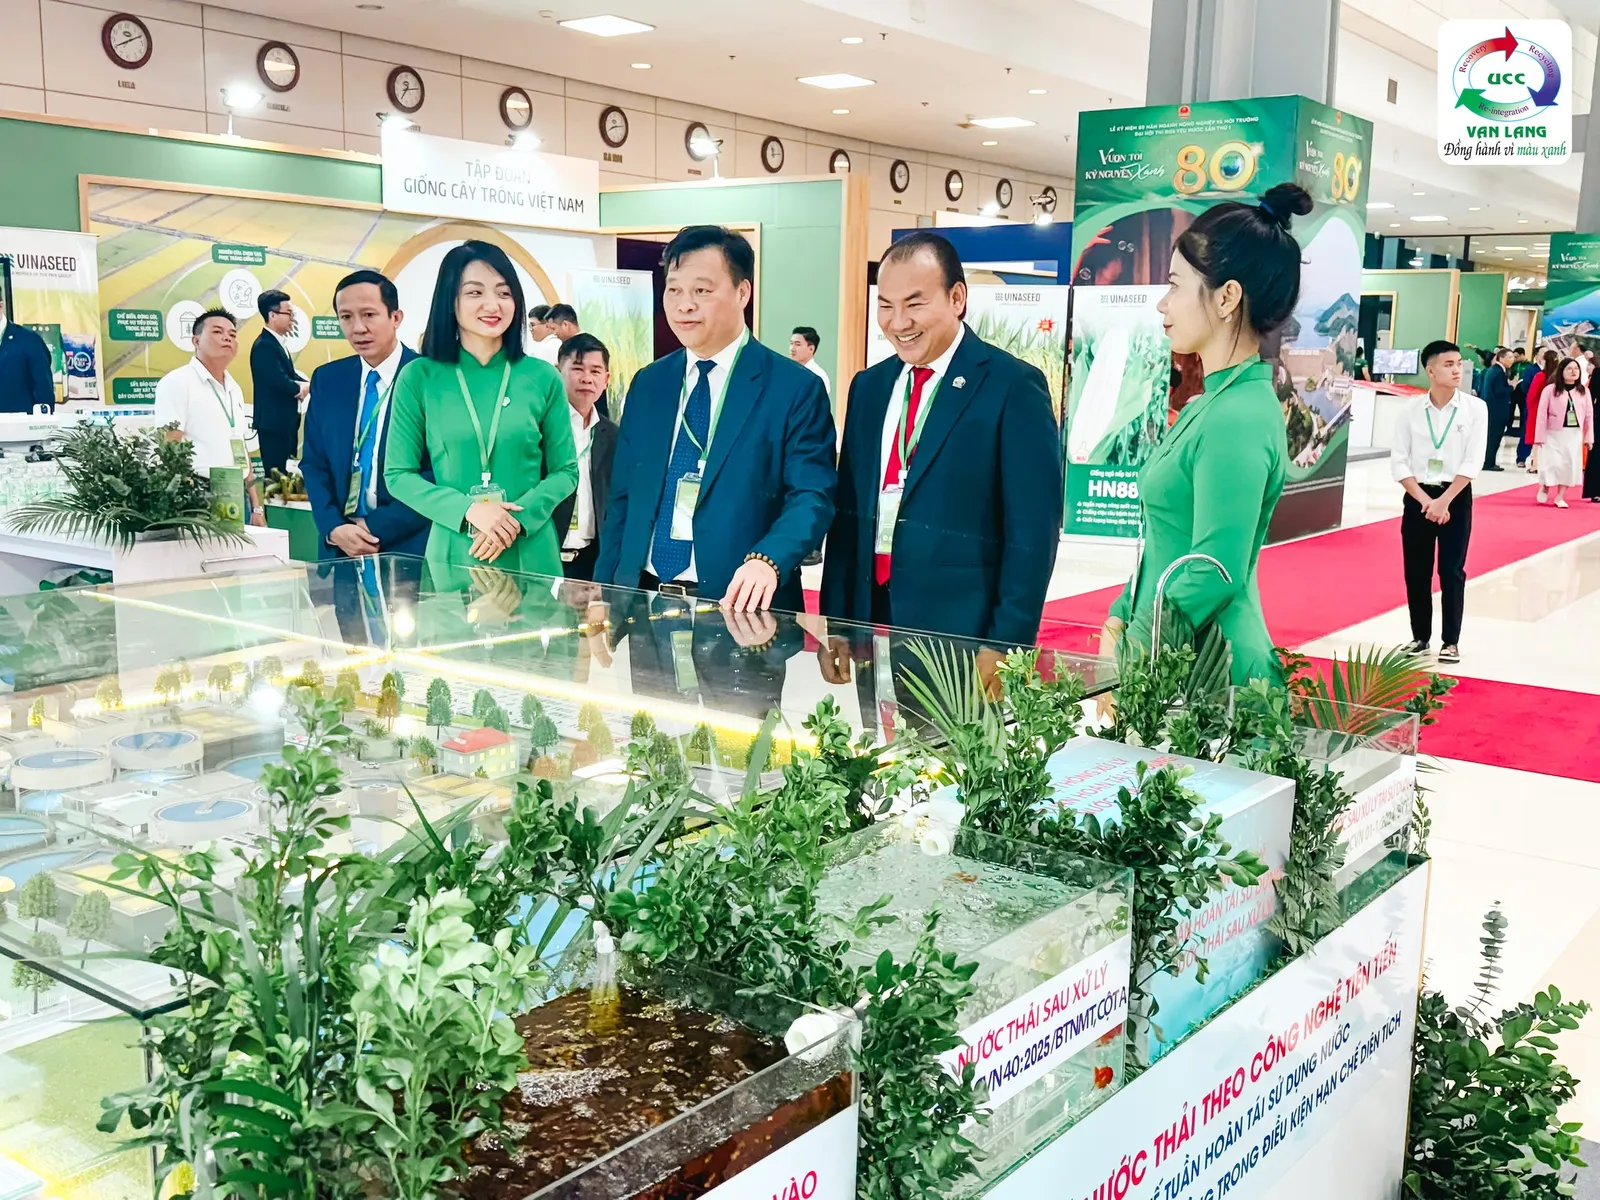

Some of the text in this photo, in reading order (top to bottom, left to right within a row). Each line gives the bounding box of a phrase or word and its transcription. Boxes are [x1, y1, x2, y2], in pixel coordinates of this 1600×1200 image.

[465, 160, 491, 184] TẬP
[1122, 163, 1166, 181] Xanh
[1173, 140, 1256, 194] 80
[1331, 152, 1361, 202] 80
[403, 173, 447, 197] GIỐNG
[451, 183, 477, 200] CÂY
[528, 191, 555, 213] VIỆT
[558, 197, 584, 213] NAM
[17, 254, 76, 271] VINASEED
[602, 276, 631, 285] VINASEED
[1004, 293, 1041, 302] VINASEED
[1110, 294, 1147, 303] VINASEED
[1088, 480, 1139, 498] HN88
[1007, 1002, 1040, 1045] THẢI
[1043, 986, 1070, 1022] SAU
[1073, 968, 1093, 1004] XỬ
[1094, 960, 1109, 991] LÝ
[1080, 932, 1398, 1200] ƯỚC THẢI THEO CÔNG NGHỆ TIÊN TIẾN
[1204, 1115, 1243, 1170] HOÀN
[1247, 1096, 1265, 1131] TÁI
[1268, 1075, 1285, 1112] SỬ
[1285, 1058, 1318, 1098] DỤNG
[1319, 1022, 1351, 1066] NƯỚC
[1217, 1010, 1403, 1200] TRONG ĐIỀU KIỆN HẠN CHẾ DIỆN TÍCH
[772, 1170, 817, 1200] ÀO
